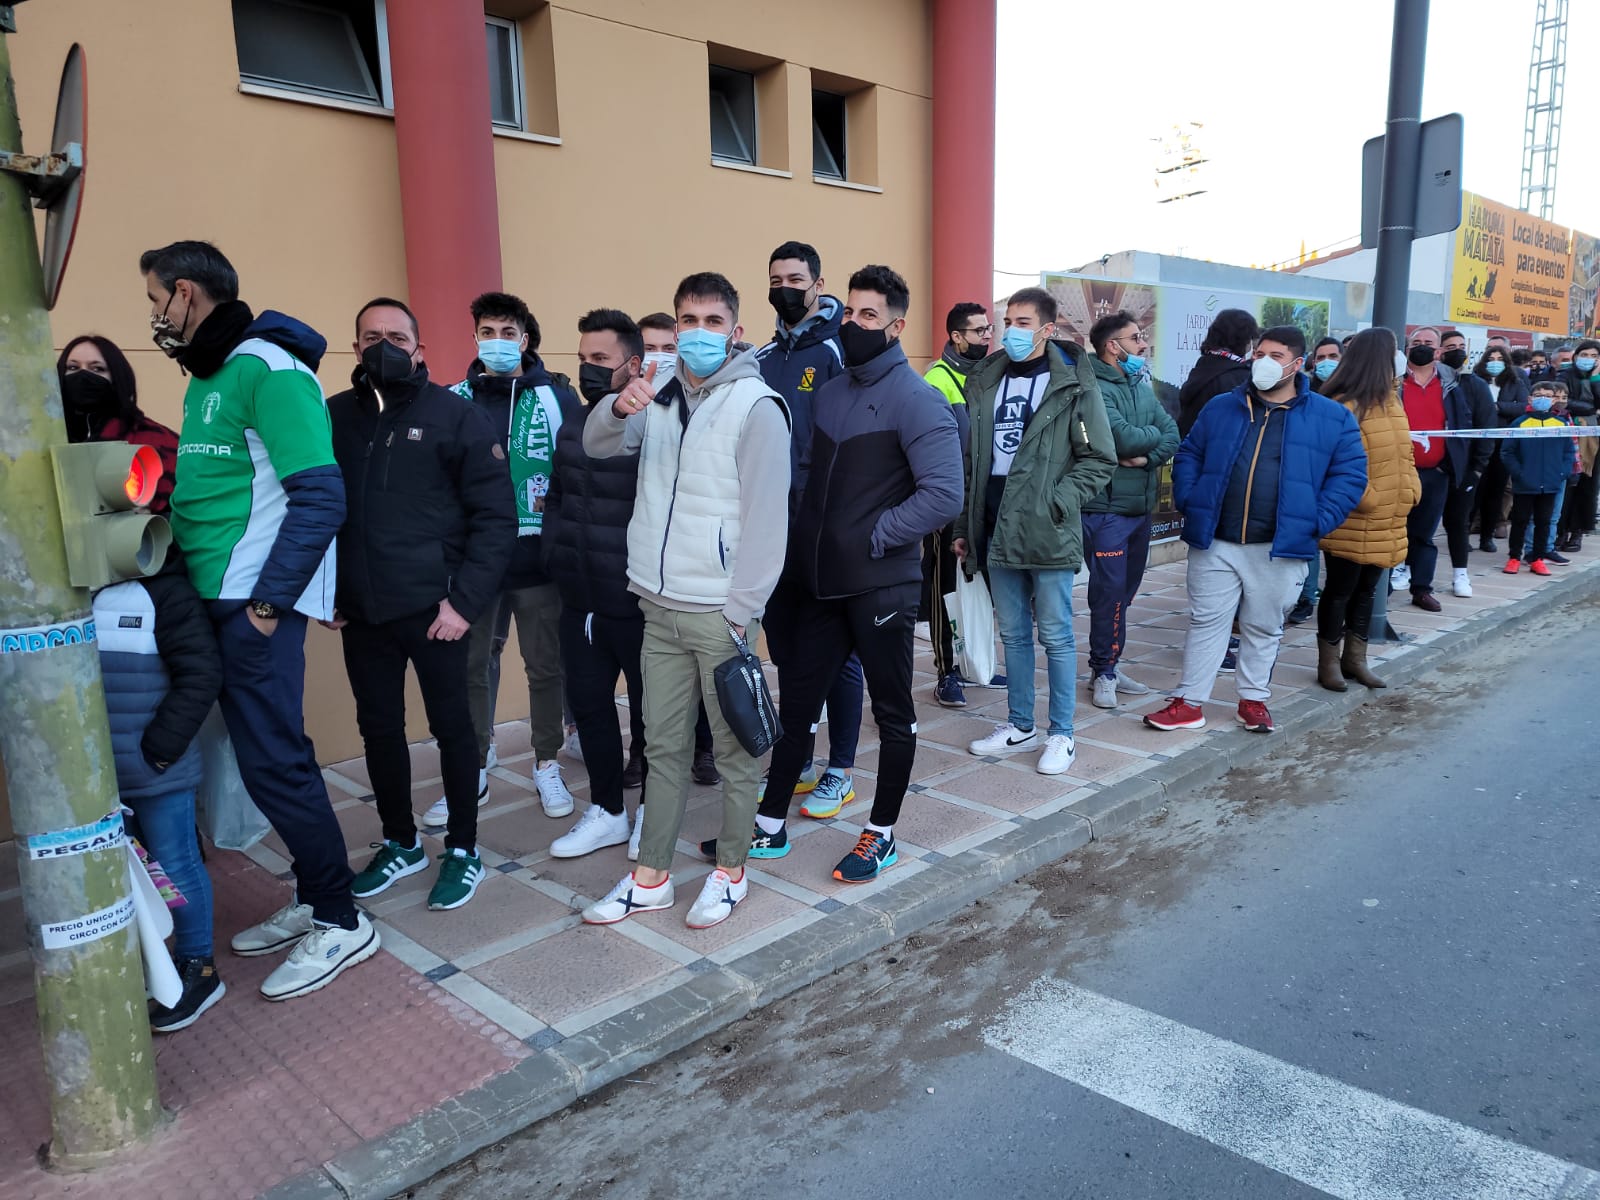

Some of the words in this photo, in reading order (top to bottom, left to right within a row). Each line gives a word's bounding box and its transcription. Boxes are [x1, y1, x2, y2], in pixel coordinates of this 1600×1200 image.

[1512, 217, 1535, 246] Local
[1535, 225, 1544, 249] de
[1463, 228, 1505, 267] MATATA
[1517, 252, 1535, 275] para
[1536, 258, 1565, 280] eventos
[1177, 332, 1189, 350] LA
[1003, 401, 1027, 420] N
[1003, 431, 1020, 449] S
[49, 922, 83, 934] PRECIO
[86, 912, 114, 926] UNICO
[70, 928, 98, 941] CIRCO
[101, 920, 118, 932] CON
